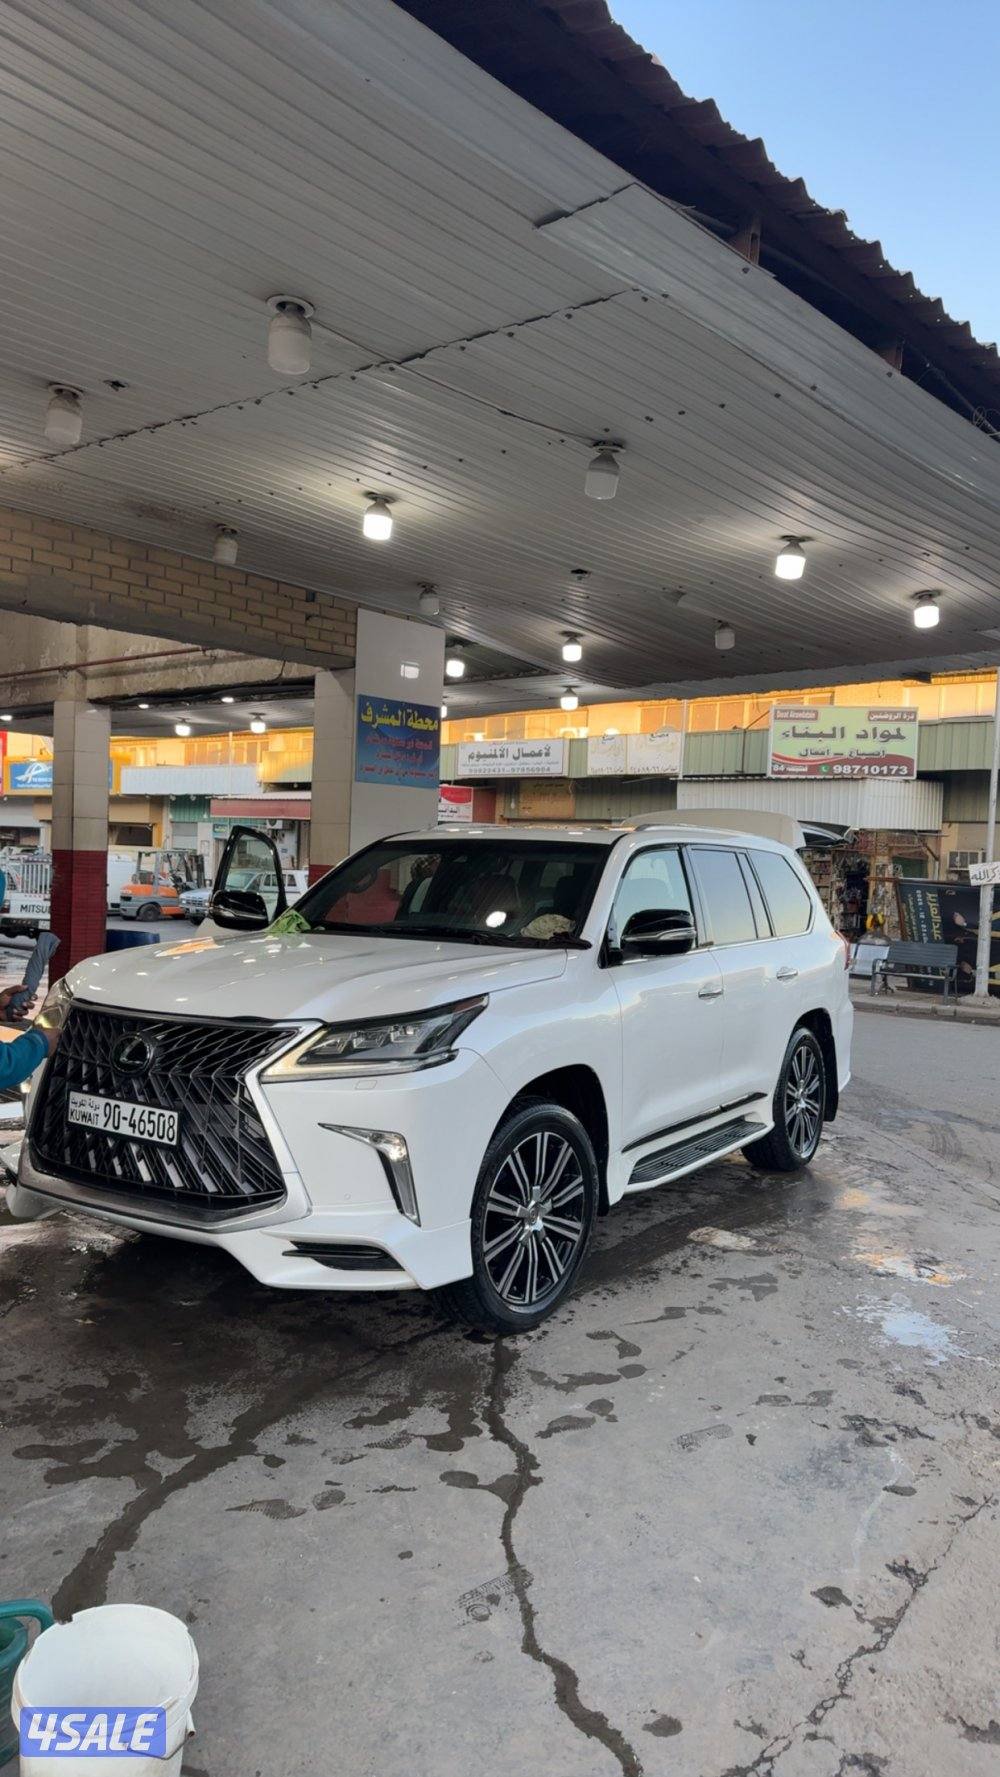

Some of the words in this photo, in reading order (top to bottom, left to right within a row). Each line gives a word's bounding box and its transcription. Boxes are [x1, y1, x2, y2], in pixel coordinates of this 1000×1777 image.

[361, 701, 406, 729] المشرف
[407, 708, 439, 731] محطة
[782, 725, 846, 742] البناء
[833, 764, 908, 775] 98710173
[970, 869, 990, 881] الله
[70, 1108, 99, 1126] KUWAIT
[103, 1101, 176, 1142] 90-46508
